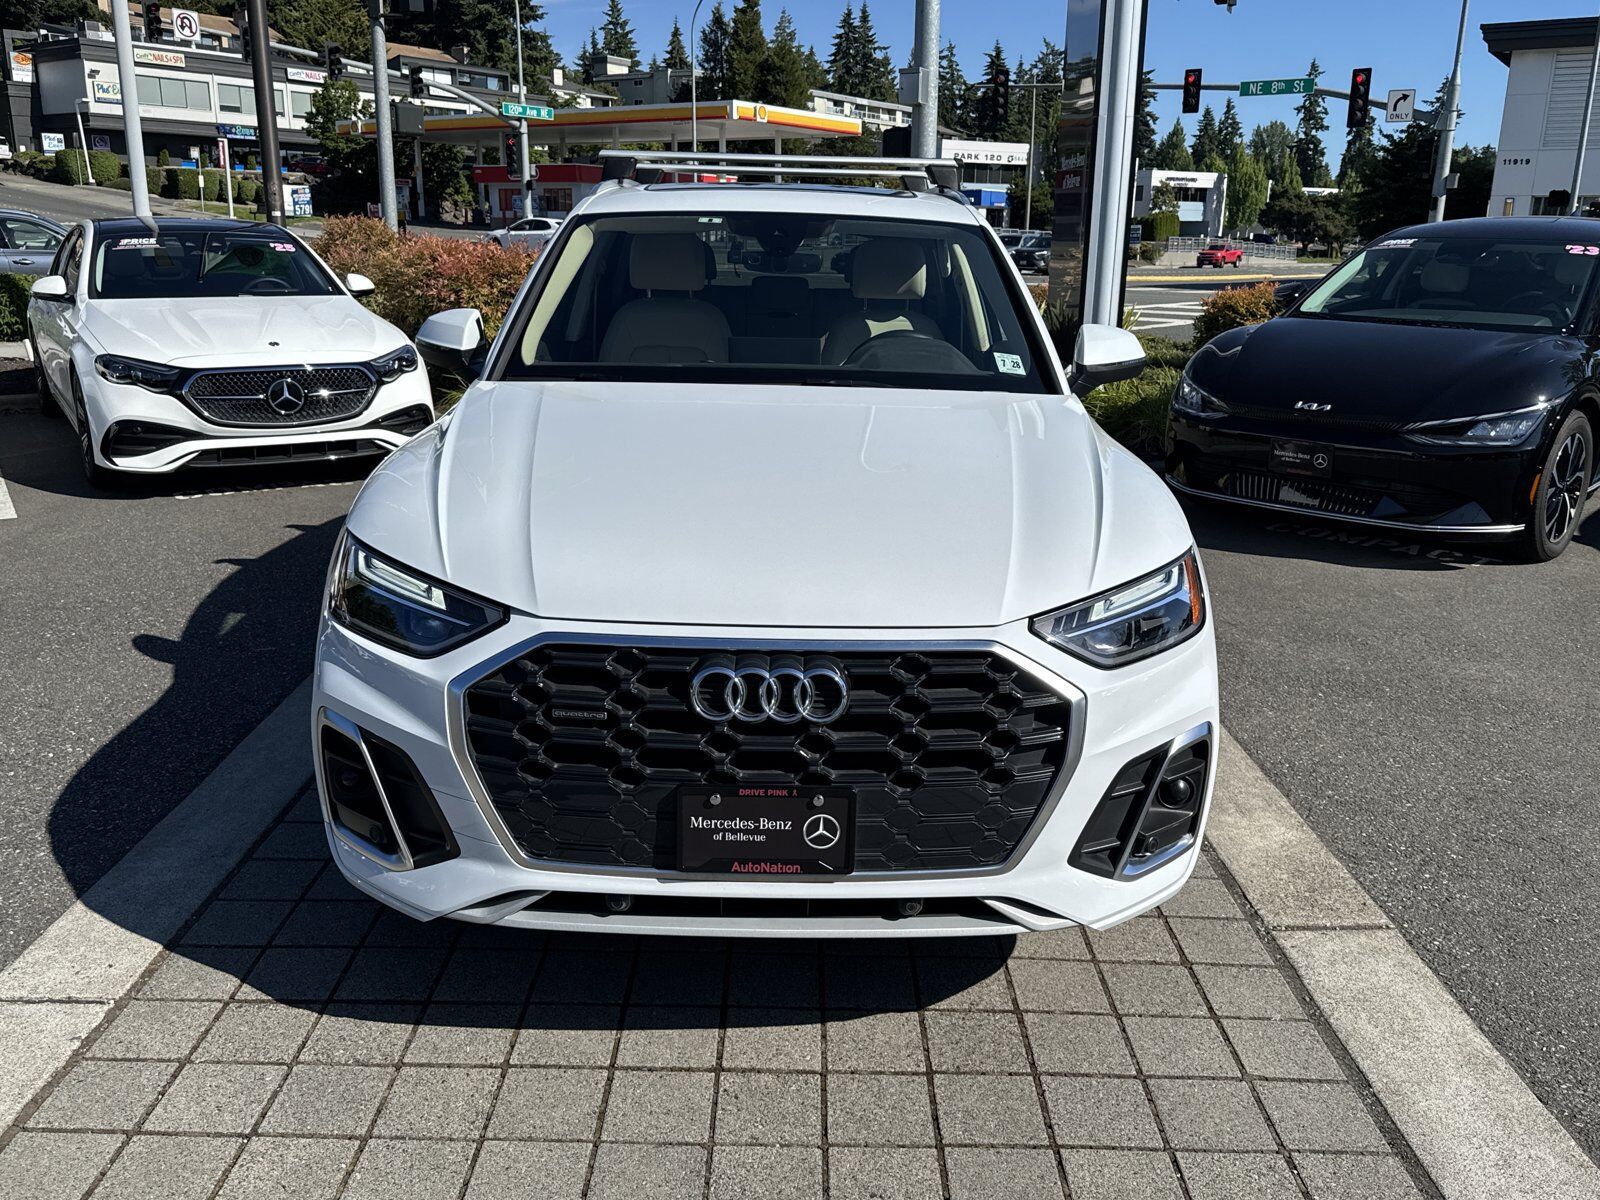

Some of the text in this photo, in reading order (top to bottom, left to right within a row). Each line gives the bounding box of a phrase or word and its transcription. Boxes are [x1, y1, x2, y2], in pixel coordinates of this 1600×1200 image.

[152, 54, 168, 62] NAILS
[173, 56, 184, 64] SPA
[305, 71, 321, 80] NAILS
[1249, 80, 1304, 94] NE 8th St
[508, 105, 549, 118] 120th Ave NE
[954, 152, 979, 161] PARK
[985, 154, 1002, 162] 120
[1503, 158, 1531, 166] 11919
[1000, 359, 1022, 369] 7 28
[554, 710, 604, 718] quattro
[767, 789, 789, 797] PINK
[690, 816, 792, 831] Mercedes-Benz
[713, 832, 767, 842] of Bellevue
[731, 861, 801, 874] AutoNation
